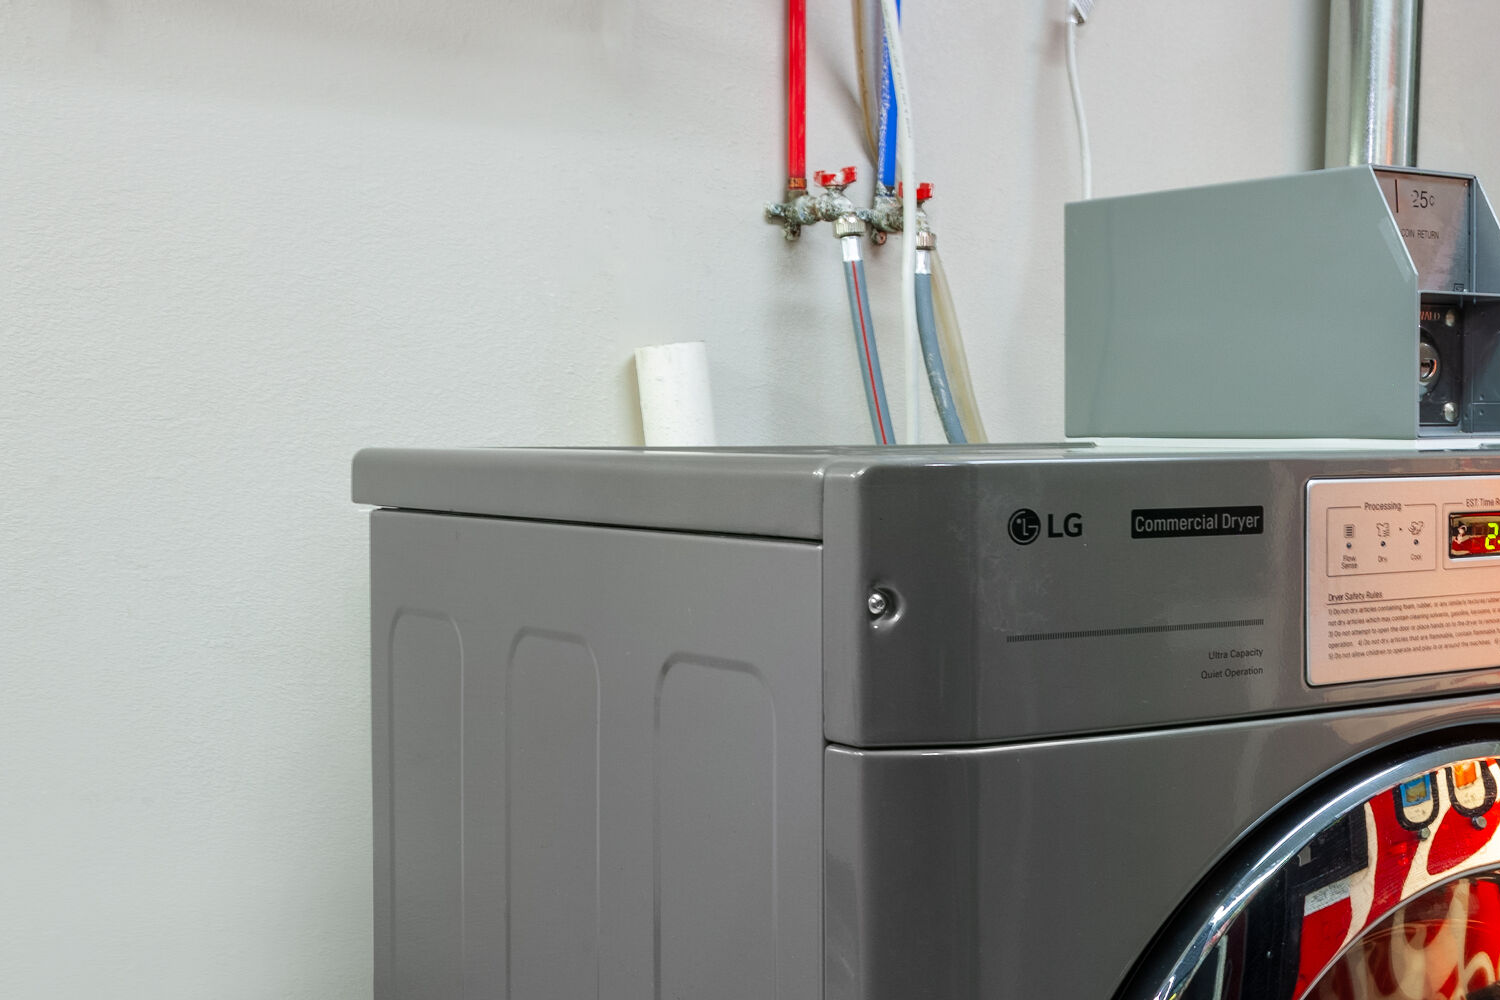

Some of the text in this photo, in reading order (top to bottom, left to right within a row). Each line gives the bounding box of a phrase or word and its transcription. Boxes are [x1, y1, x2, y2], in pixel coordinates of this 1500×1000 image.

[1417, 229, 1439, 239] RETURN
[1364, 501, 1402, 512] Processing
[1480, 498, 1494, 507] Time
[1048, 513, 1082, 538] LG
[1135, 513, 1260, 533] Commercial Dryer
[1328, 591, 1383, 602] Dryer Safety Rules
[1208, 648, 1263, 660] Ultra Capacity
[1201, 666, 1263, 680] Quiet Operation
